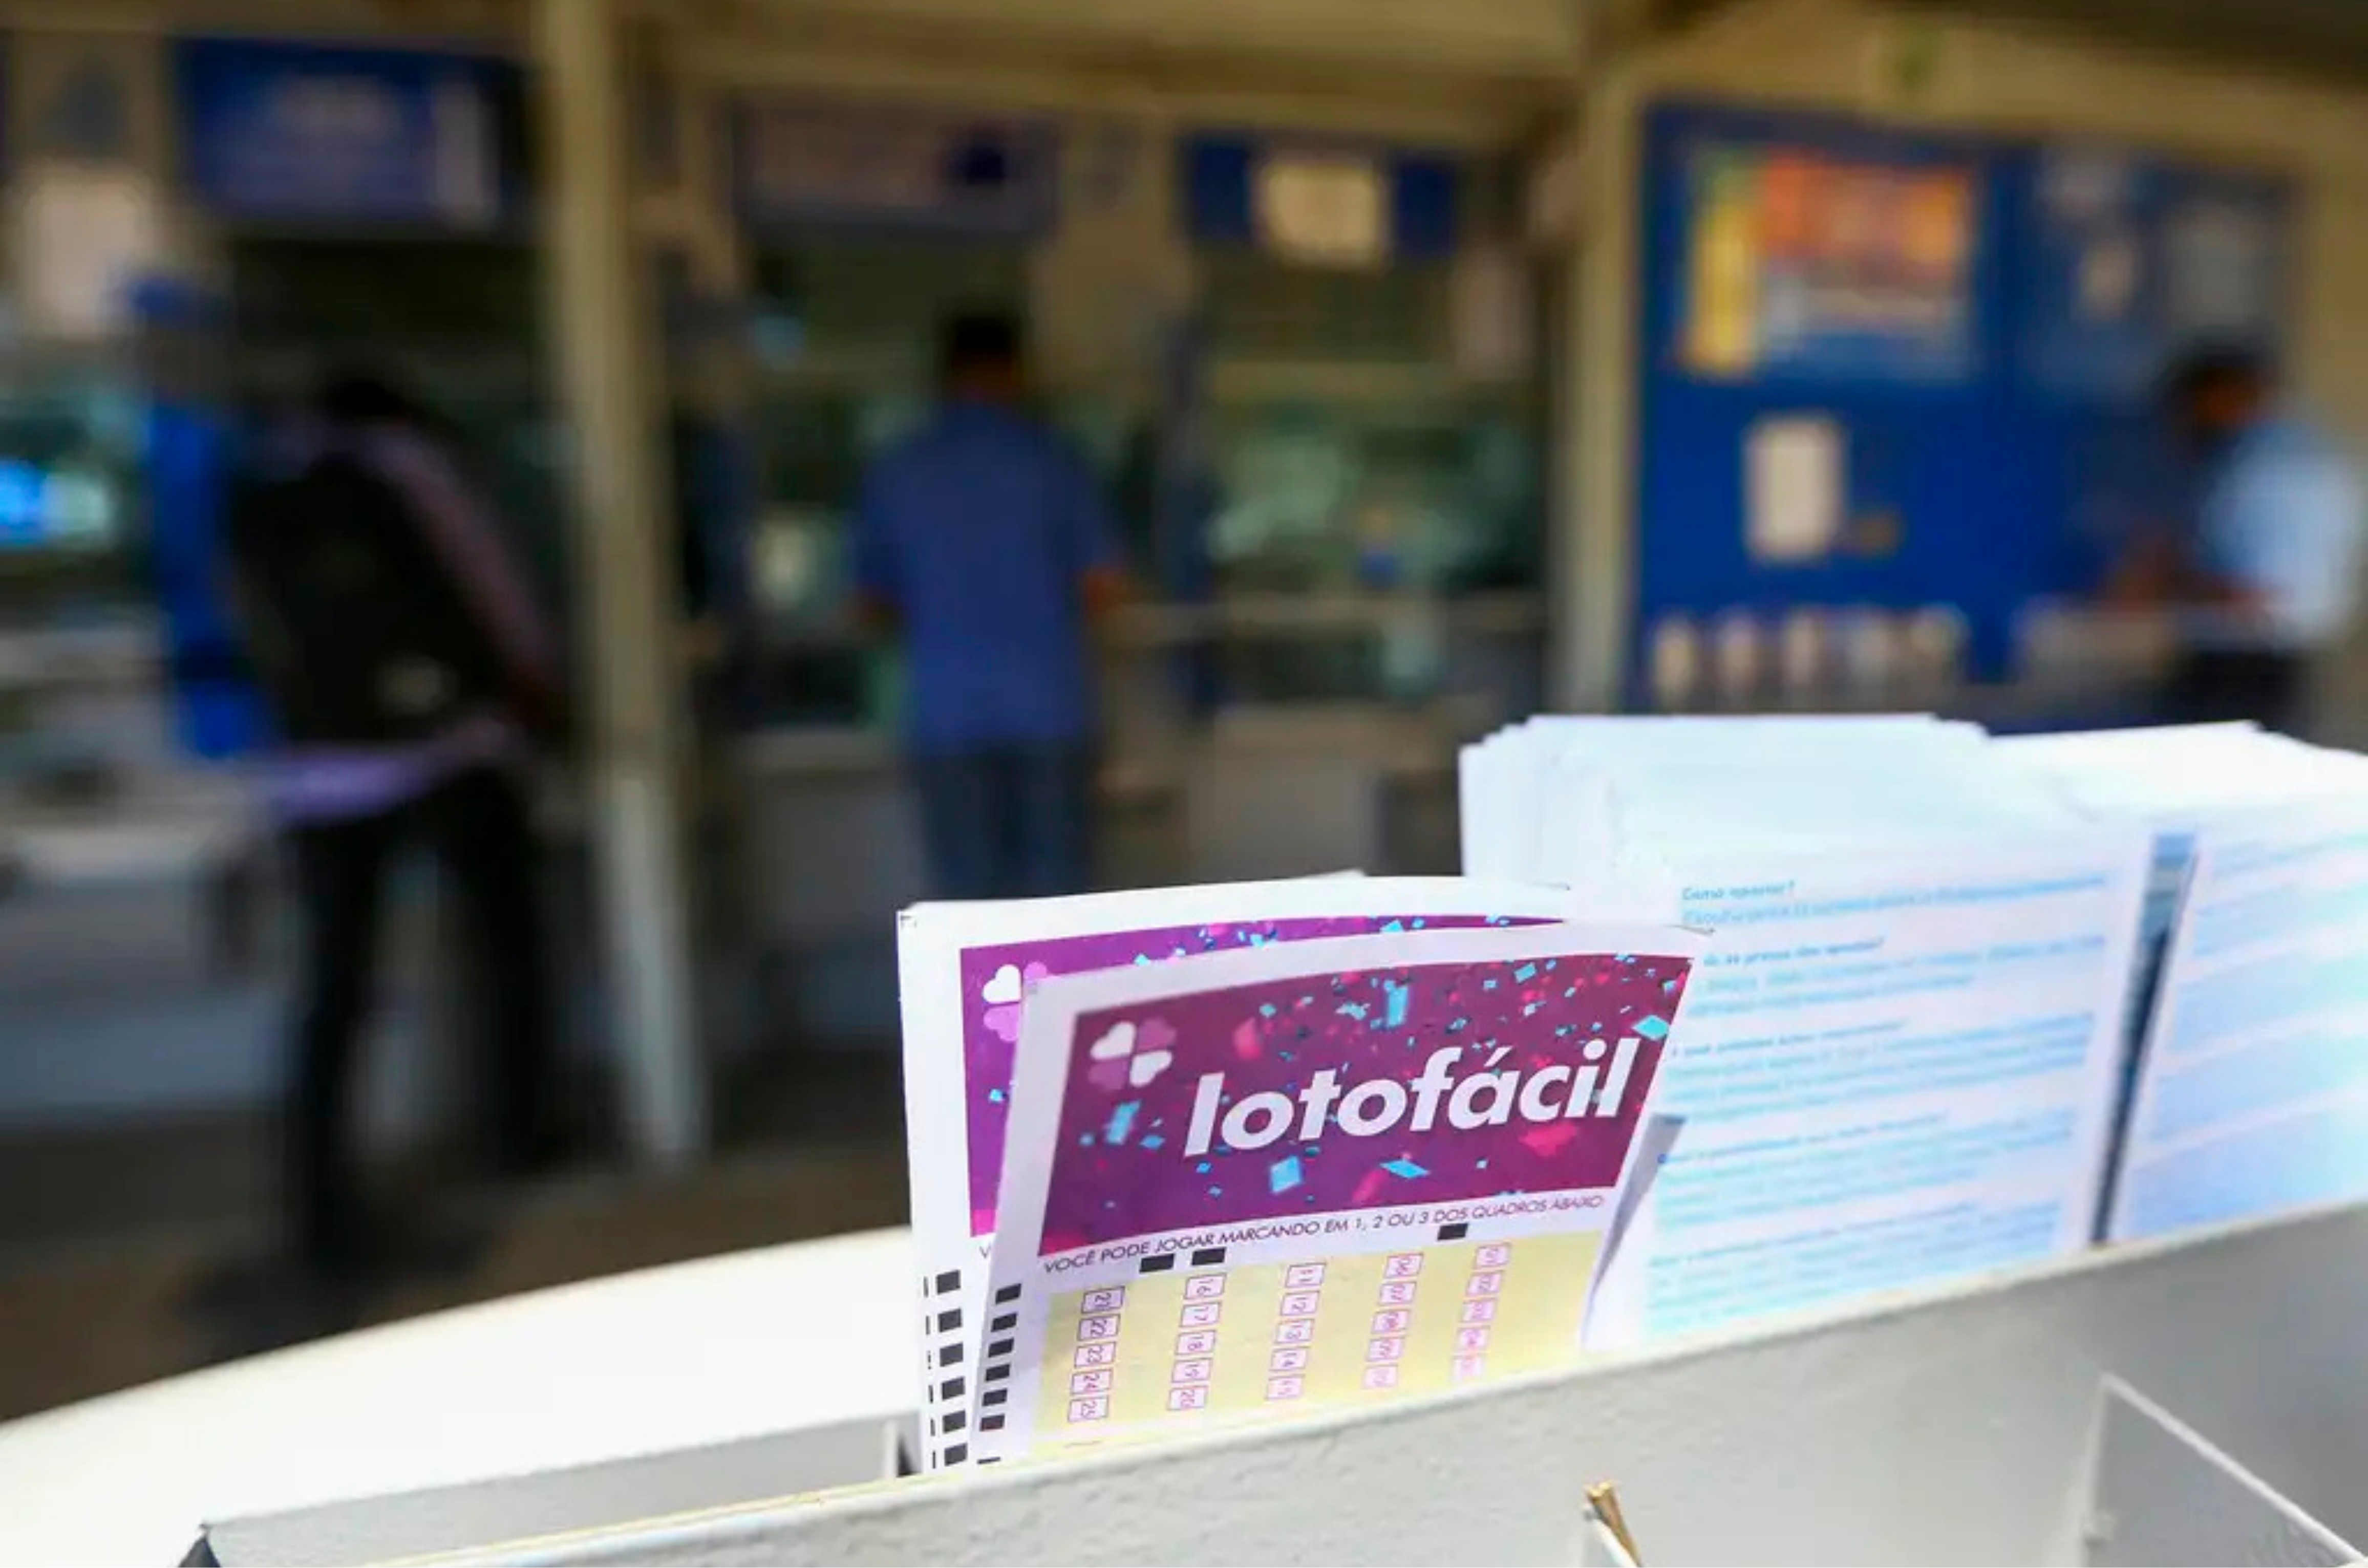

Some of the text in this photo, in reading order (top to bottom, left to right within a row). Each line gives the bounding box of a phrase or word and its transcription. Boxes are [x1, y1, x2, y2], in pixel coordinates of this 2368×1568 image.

[1184, 1038, 1641, 1157] lotofácil
[1044, 1250, 1096, 1273] VOCÊ
[1101, 1242, 1149, 1262] PODE
[1154, 1233, 1214, 1254] JOGAR
[1217, 1220, 1320, 1244] MARCANDO
[1324, 1219, 1348, 1234] EM
[1373, 1215, 1383, 1229] 2
[1388, 1212, 1413, 1227] OU
[1418, 1210, 1429, 1225] 3
[1433, 1208, 1467, 1224] DOS
[1472, 1198, 1547, 1219] QUADROS
